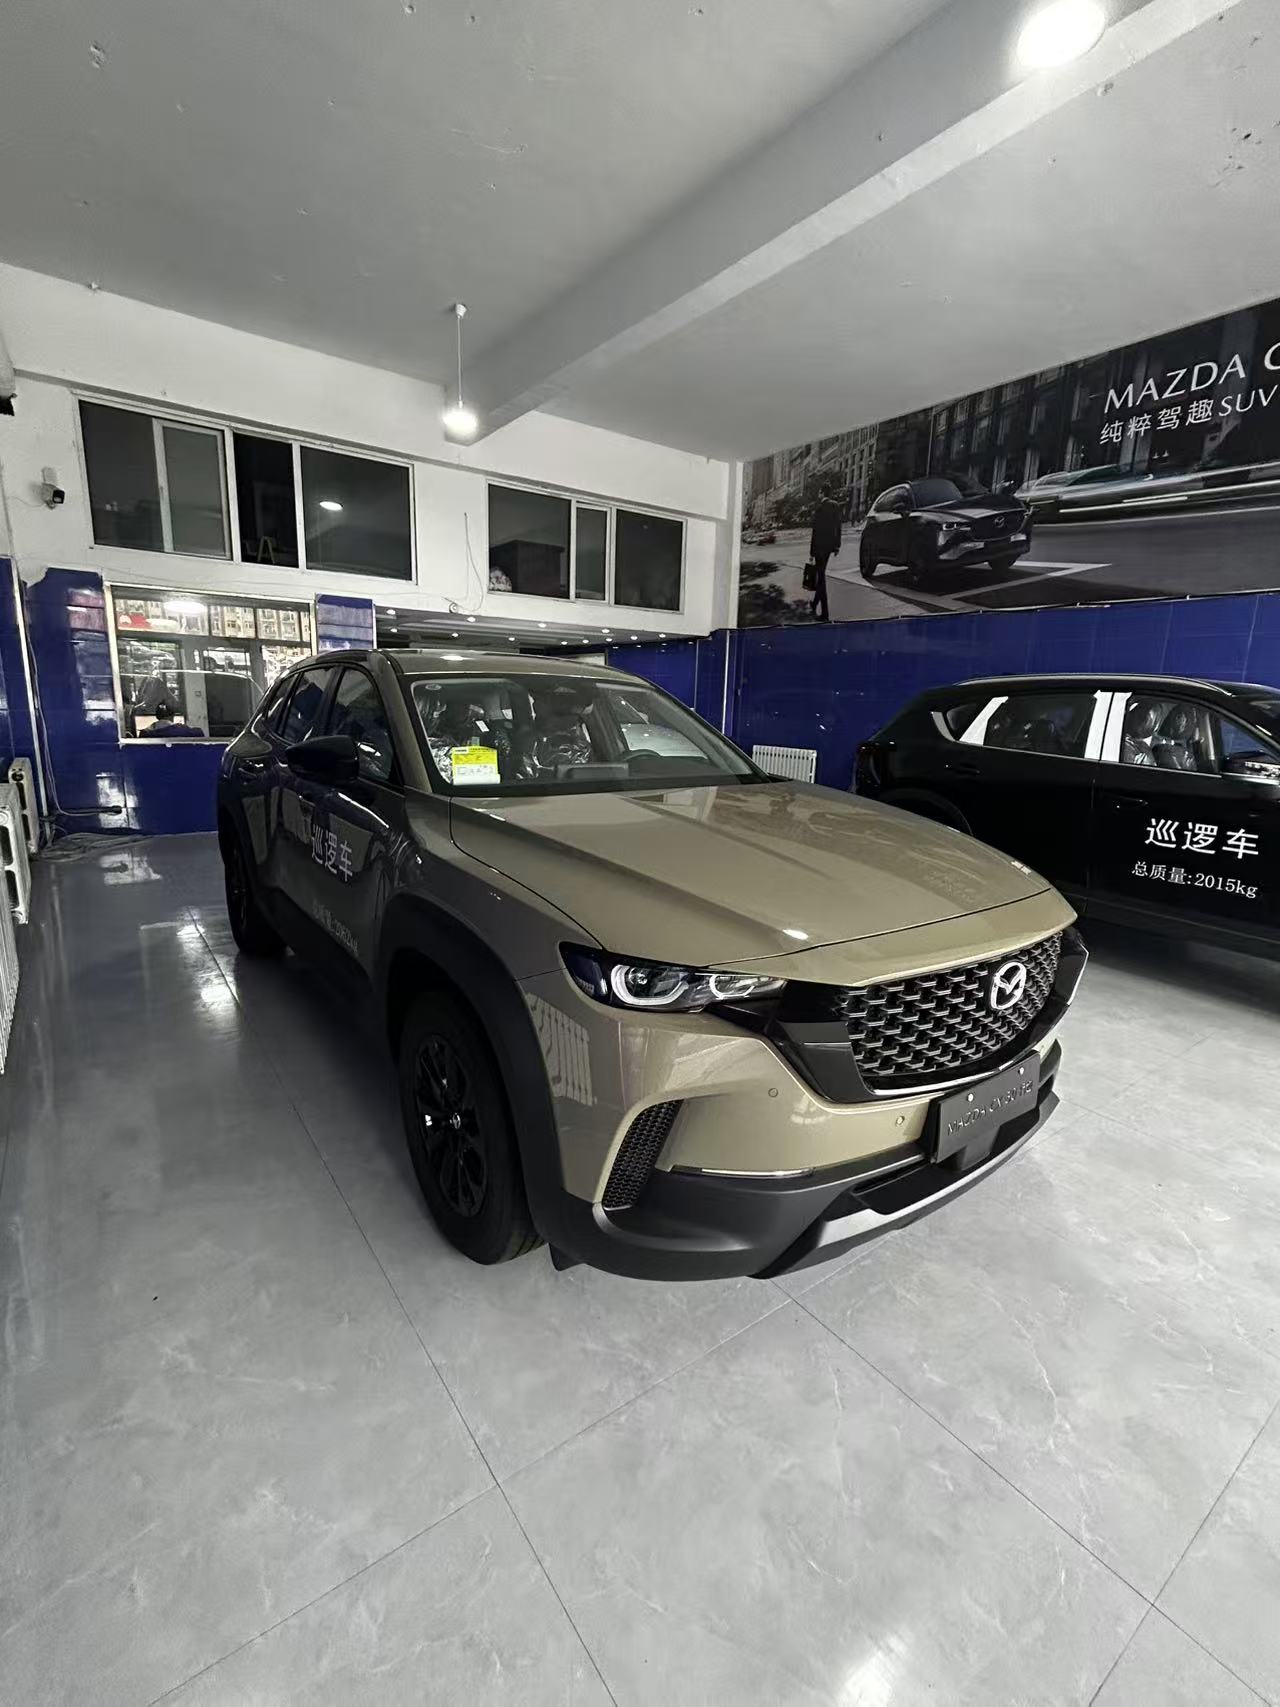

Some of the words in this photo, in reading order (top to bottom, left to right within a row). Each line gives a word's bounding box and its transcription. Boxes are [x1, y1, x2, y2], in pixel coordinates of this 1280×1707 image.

[1104, 353, 1246, 414] MAZDA
[311, 823, 353, 882] 巡逻车
[1144, 818, 1259, 859] 巡逻车
[1131, 861, 1258, 899] 总质量:2015kg
